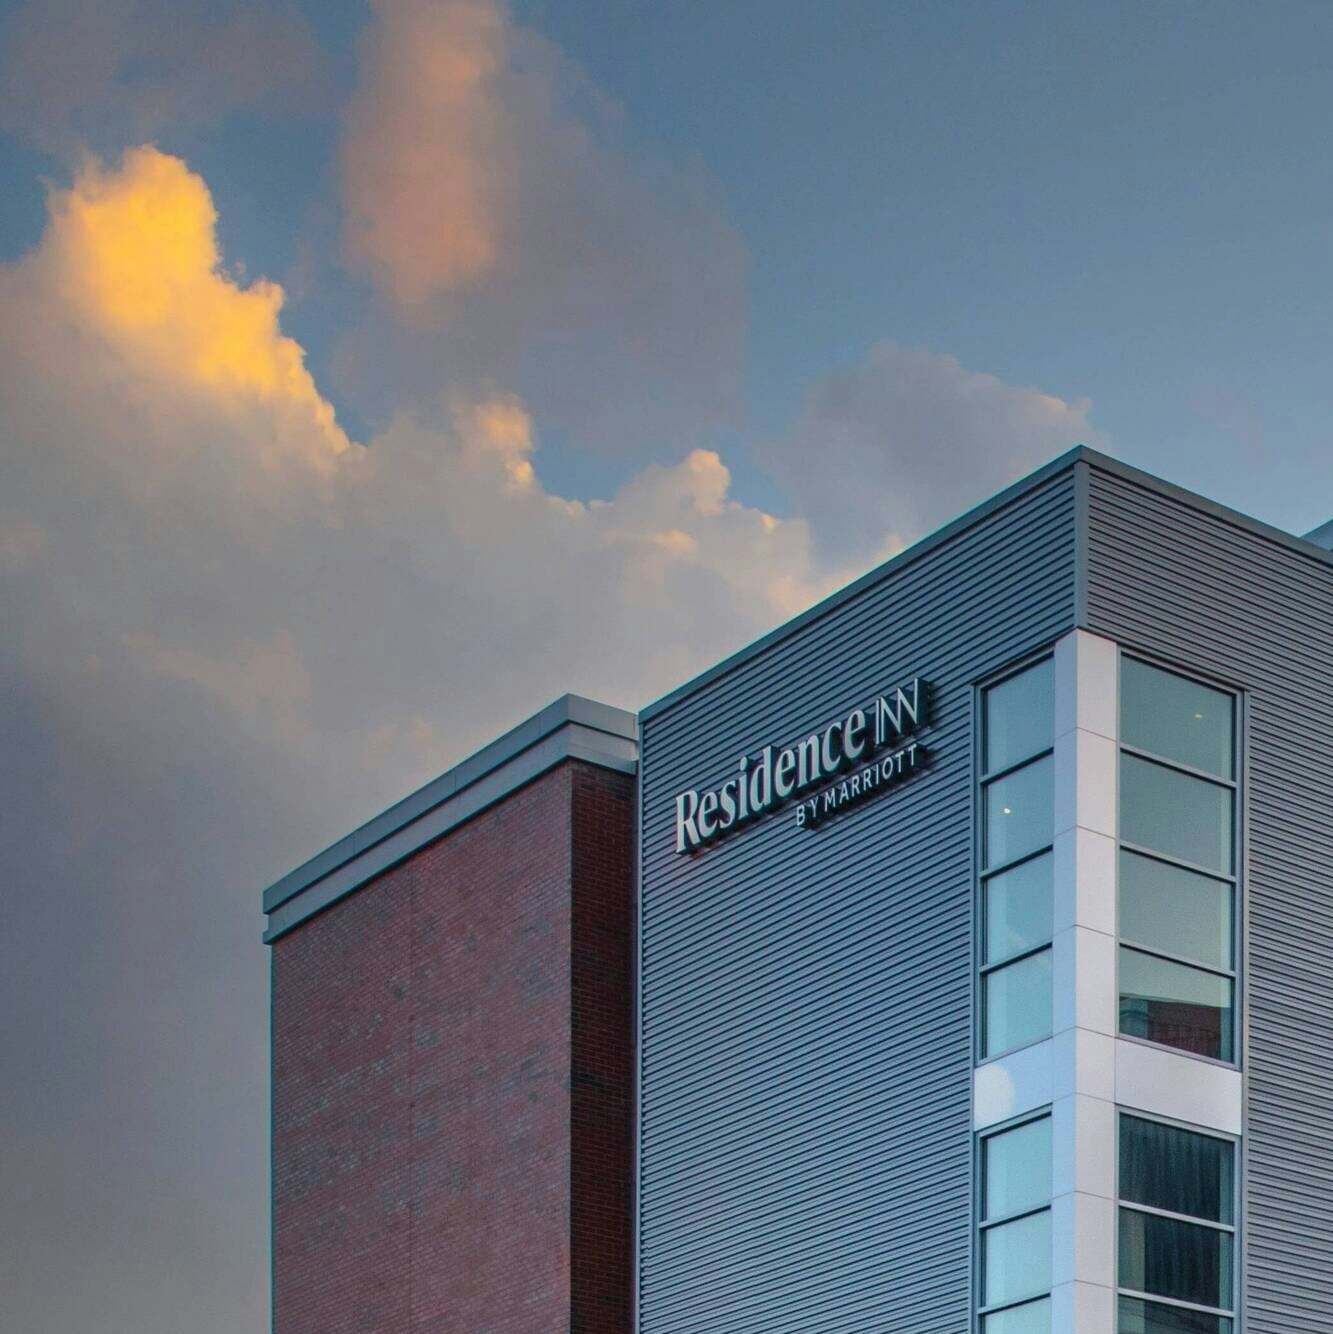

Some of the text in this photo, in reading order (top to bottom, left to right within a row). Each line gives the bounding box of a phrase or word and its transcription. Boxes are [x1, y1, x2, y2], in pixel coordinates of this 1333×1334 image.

[675, 677, 919, 853] Residence INN
[796, 743, 918, 827] BY MARRIOTT
